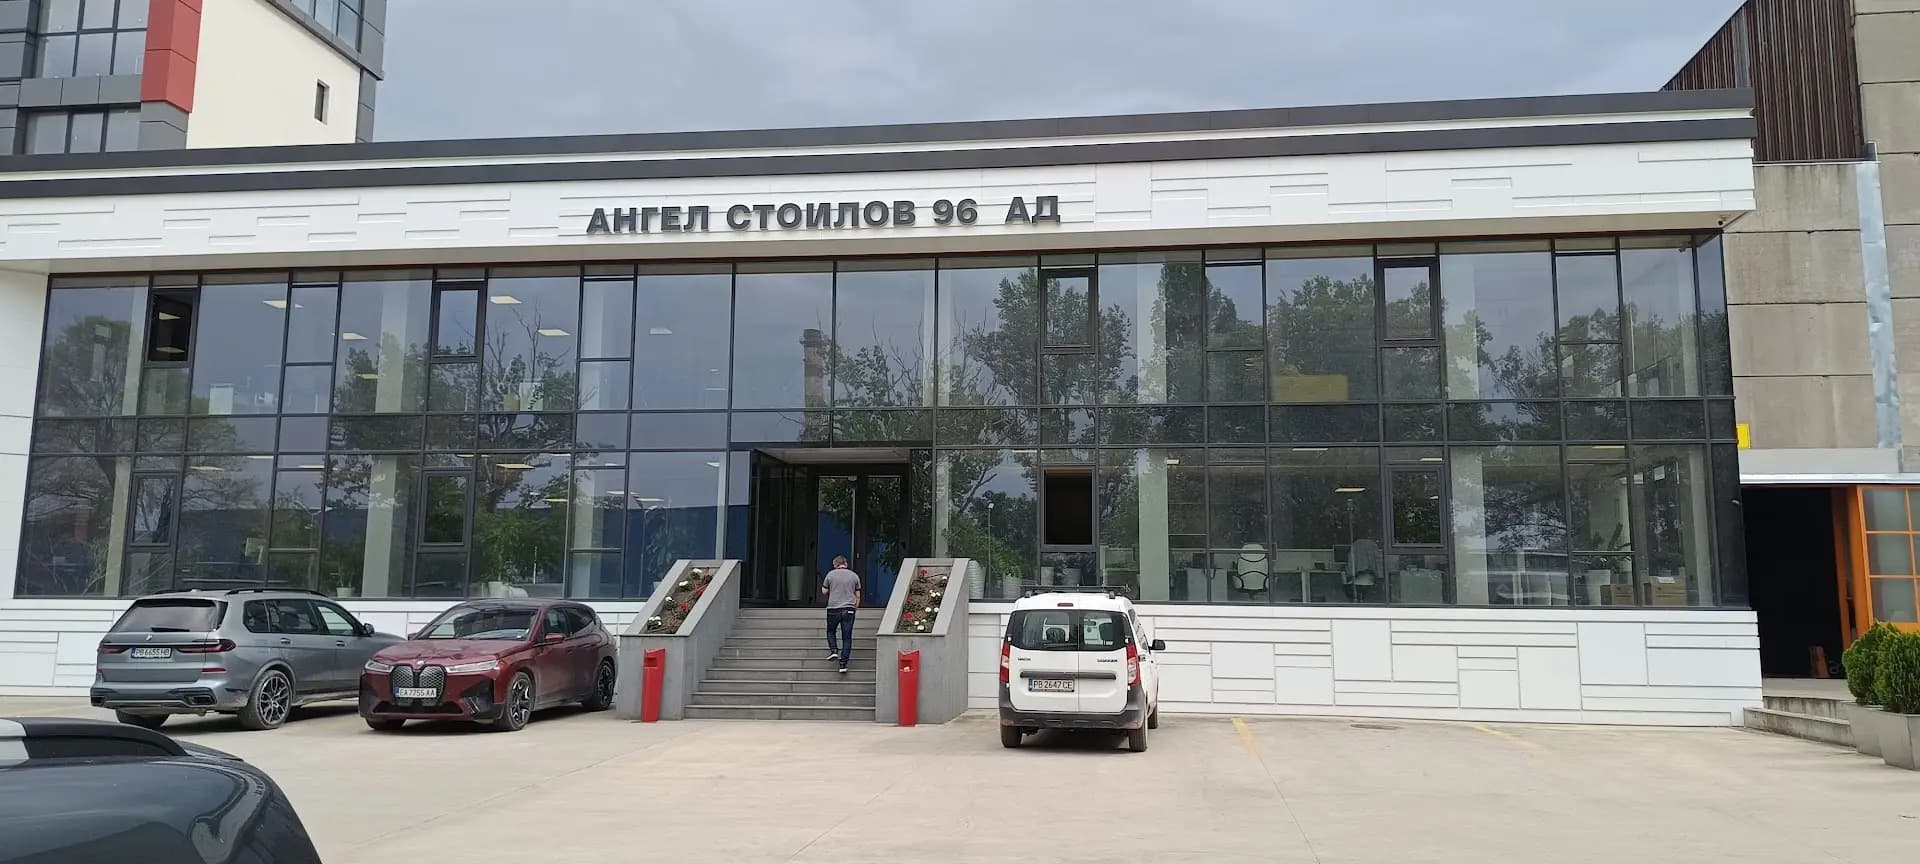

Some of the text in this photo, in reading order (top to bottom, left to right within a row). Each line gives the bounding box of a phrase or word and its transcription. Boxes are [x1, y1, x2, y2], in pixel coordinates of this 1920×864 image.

[586, 195, 1061, 233] АНГЕЛ СТОИЛОВ 96 АД
[1044, 680, 1062, 689] 2647
